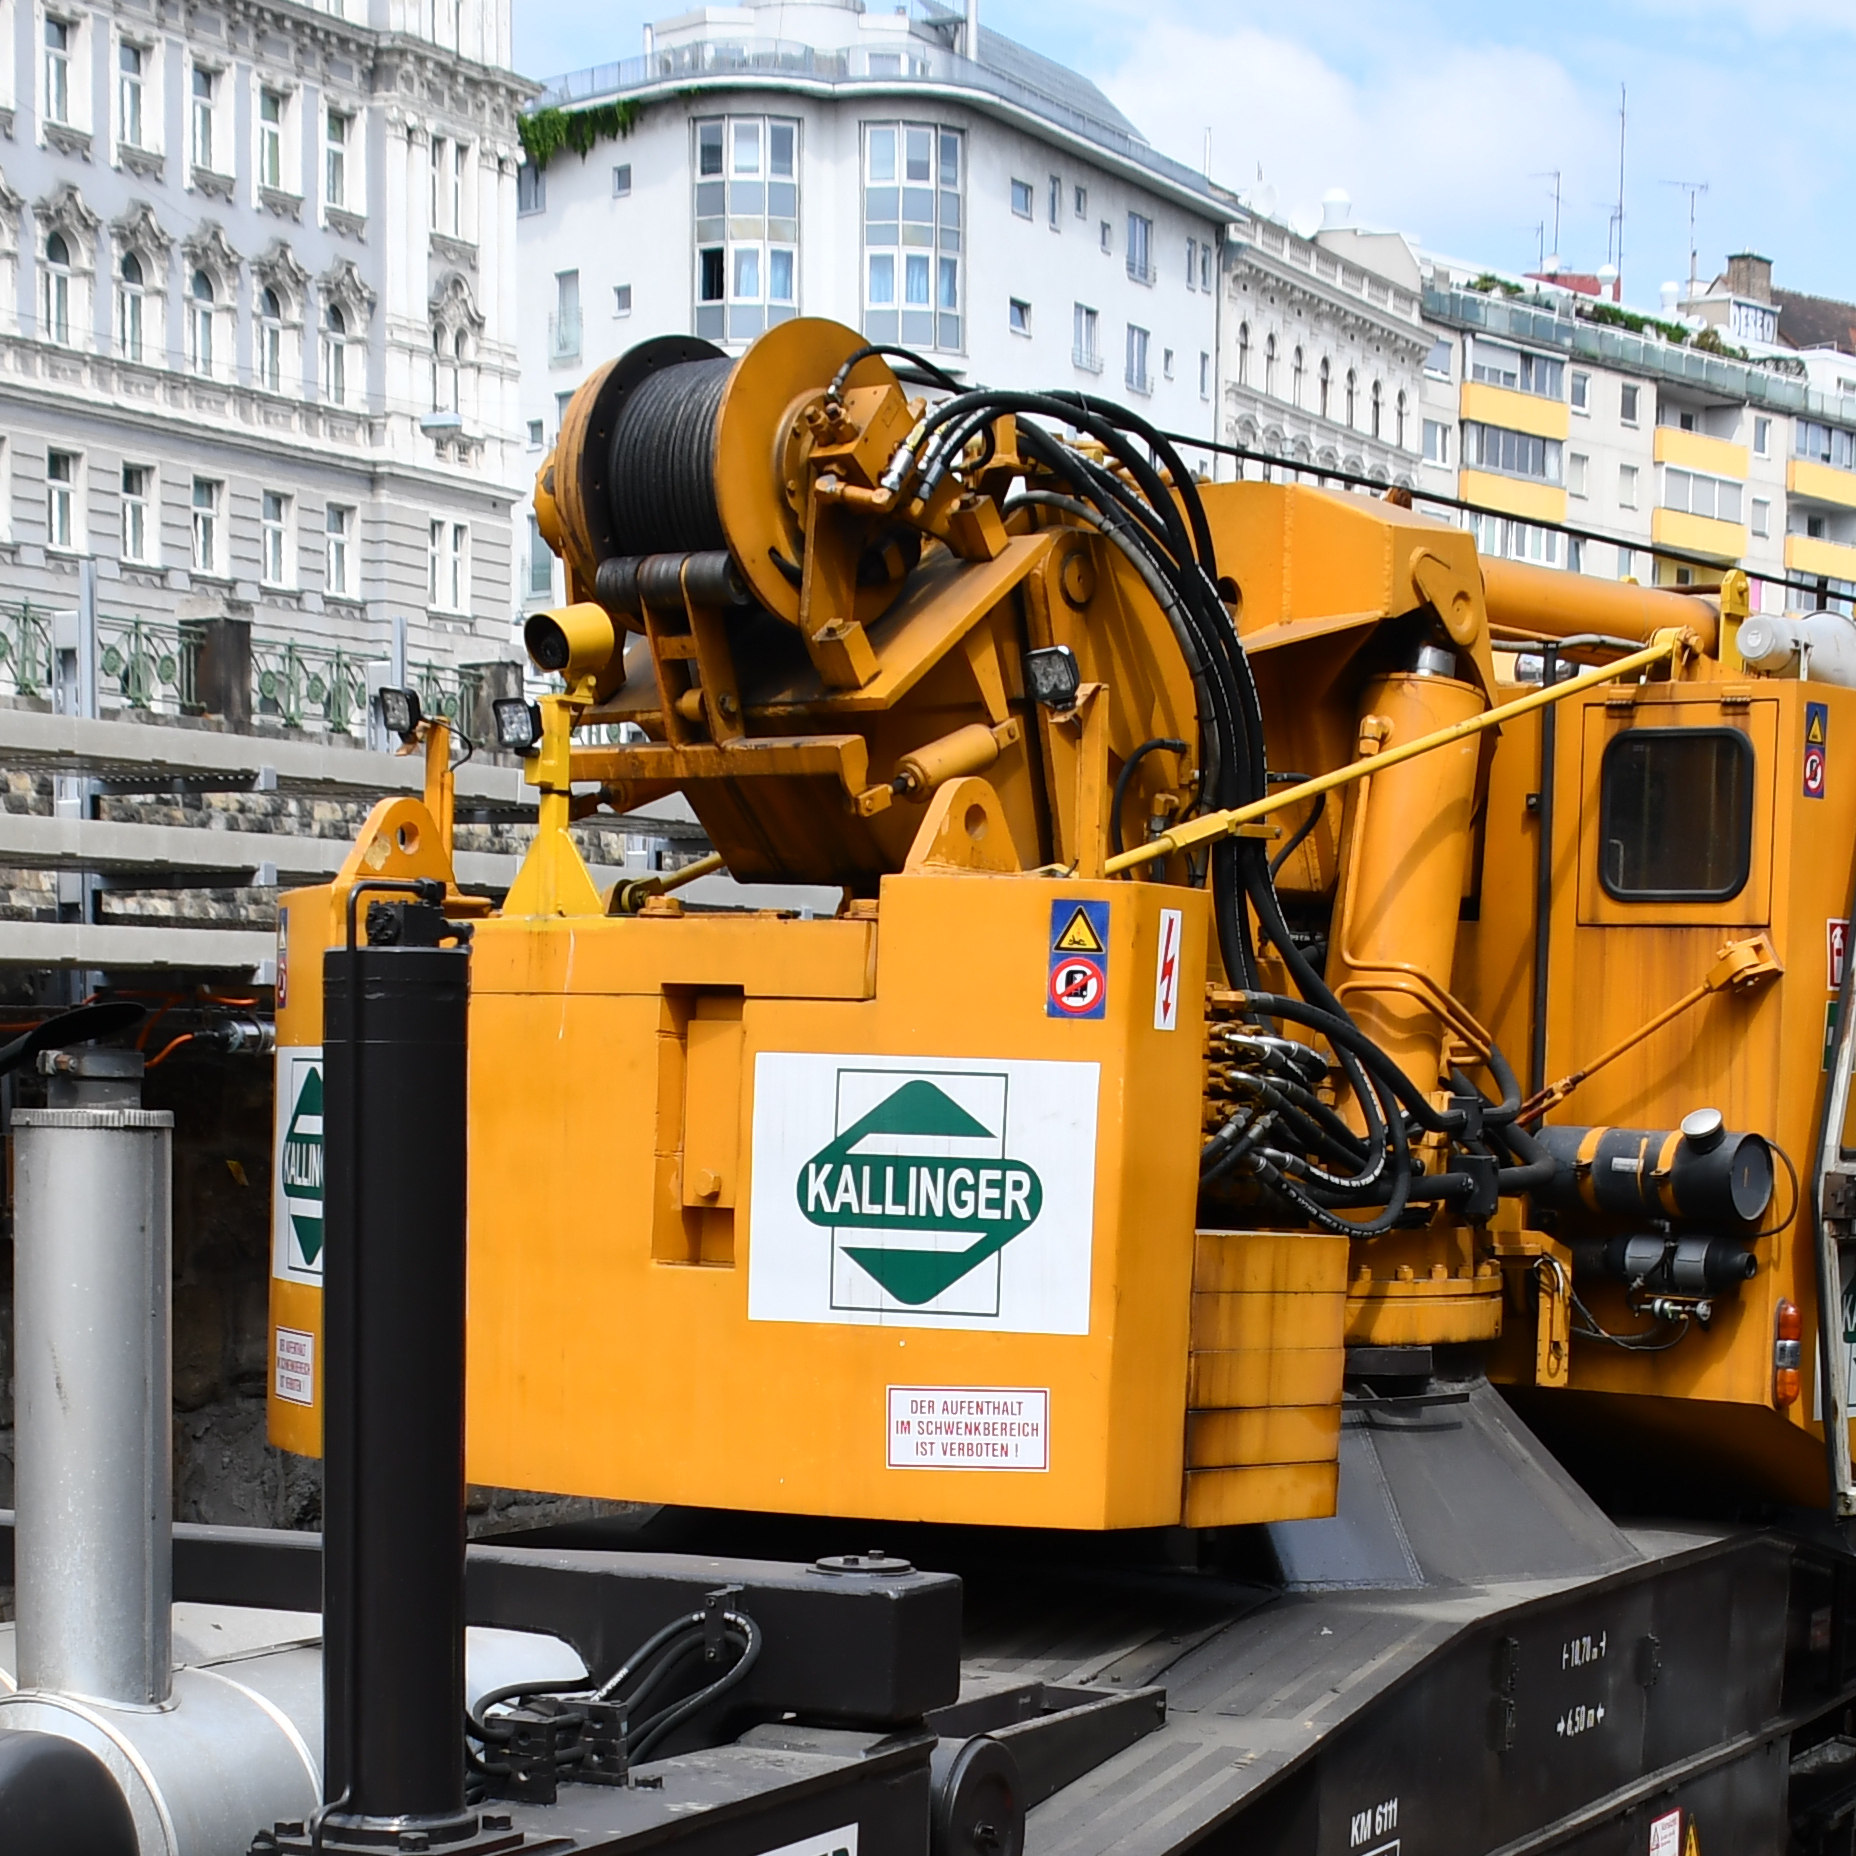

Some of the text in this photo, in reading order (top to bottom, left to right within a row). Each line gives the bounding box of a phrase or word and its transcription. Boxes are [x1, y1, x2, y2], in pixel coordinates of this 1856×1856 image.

[807, 1163, 1032, 1221] KALLINGER
[910, 1399, 1024, 1416] DER AUFENTHALT
[895, 1420, 1039, 1437] IM SCHWENKBEREICH
[915, 1441, 935, 1457] IST
[941, 1442, 1009, 1458] VERBOTEN
[1350, 1797, 1398, 1848] KM 6111
